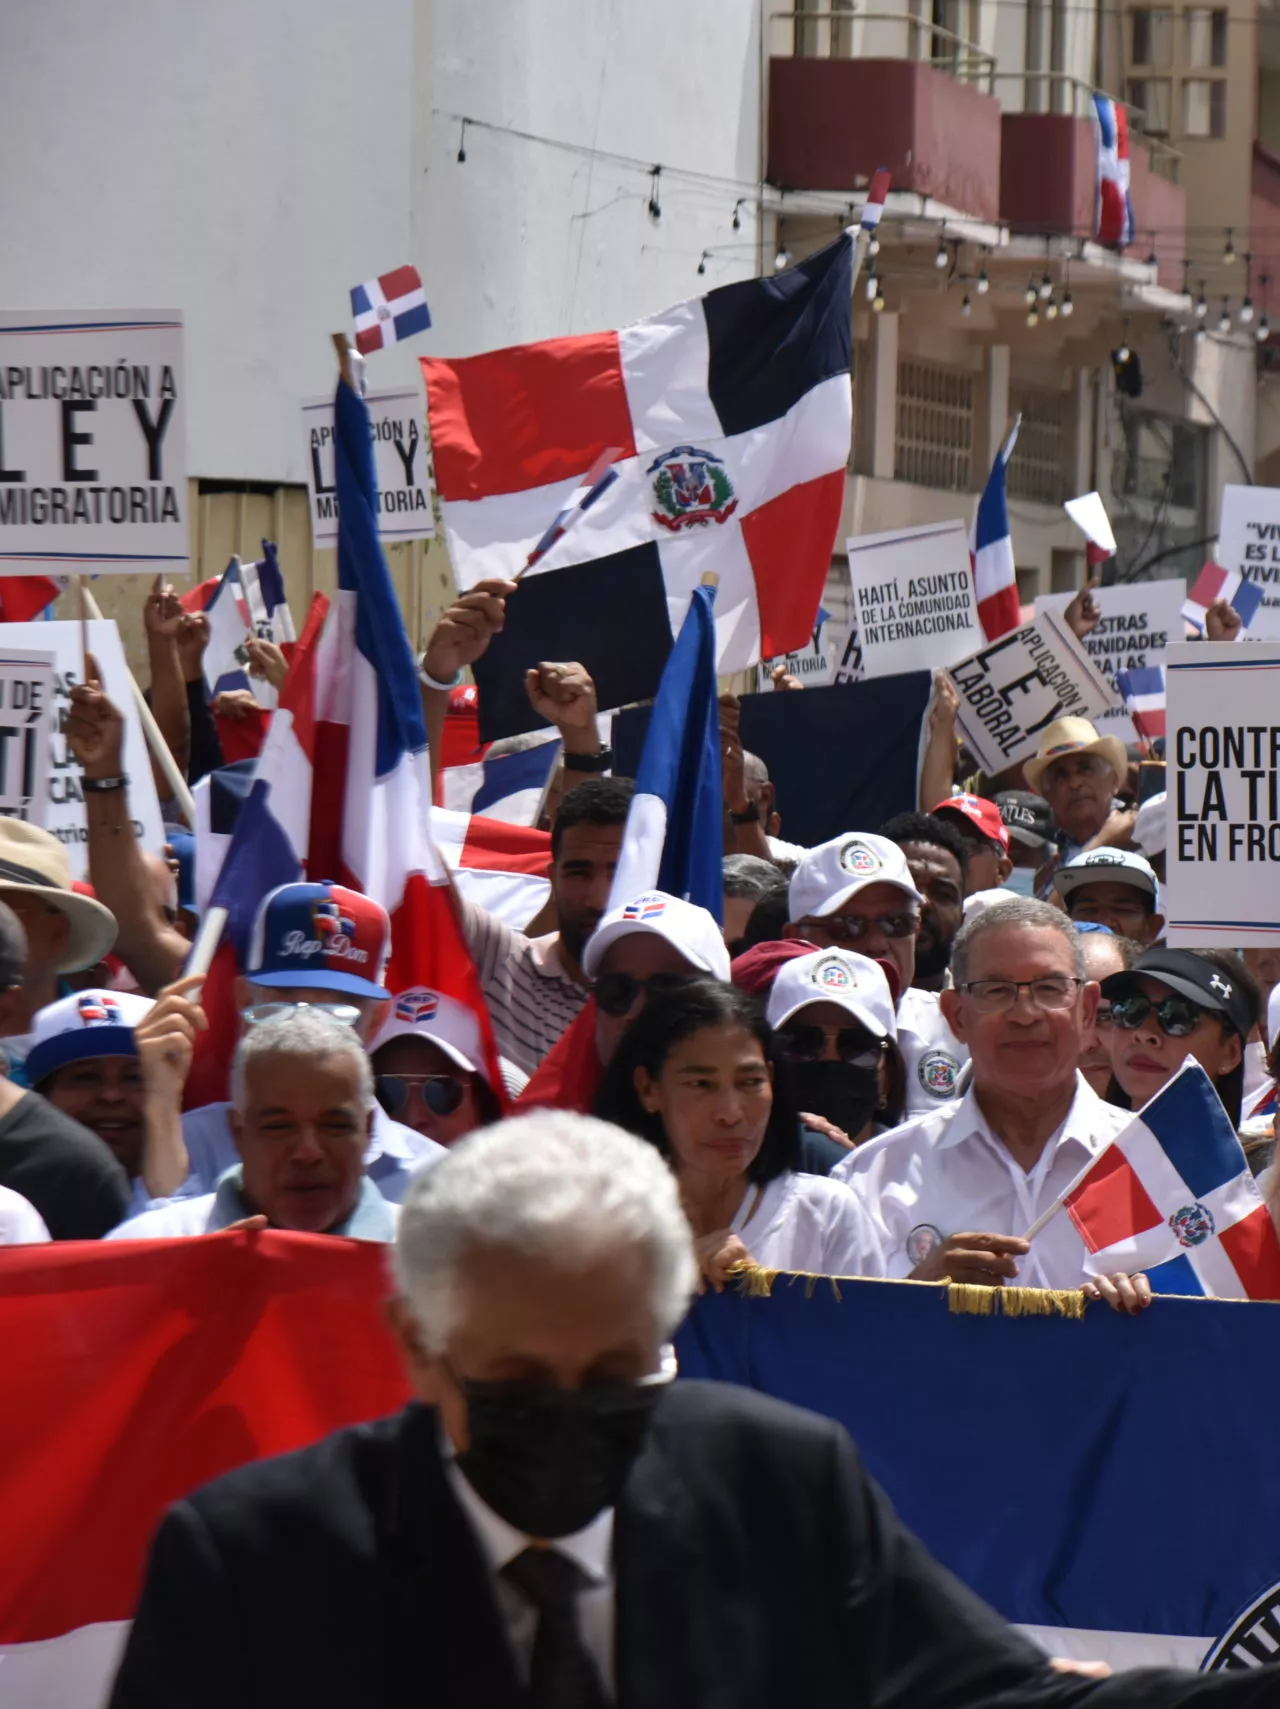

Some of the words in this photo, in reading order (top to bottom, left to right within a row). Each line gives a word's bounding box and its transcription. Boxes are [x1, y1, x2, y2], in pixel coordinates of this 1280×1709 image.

[160, 365, 177, 399] A
[408, 418, 419, 440] A
[311, 437, 419, 494] LY
[1245, 543, 1267, 560] ES
[908, 571, 969, 599] ASUNTO
[861, 608, 878, 625] DE
[880, 606, 896, 622] LA
[899, 593, 971, 618] COMUNIDAD
[864, 612, 973, 645] INTERNACIONAL
[1017, 626, 1083, 708] APLICACIÓN
[13, 680, 43, 711] DE
[976, 633, 1064, 736] LEY
[950, 658, 1027, 759] LABORAL
[1177, 770, 1228, 821] LA
[1178, 823, 1217, 861] EN
